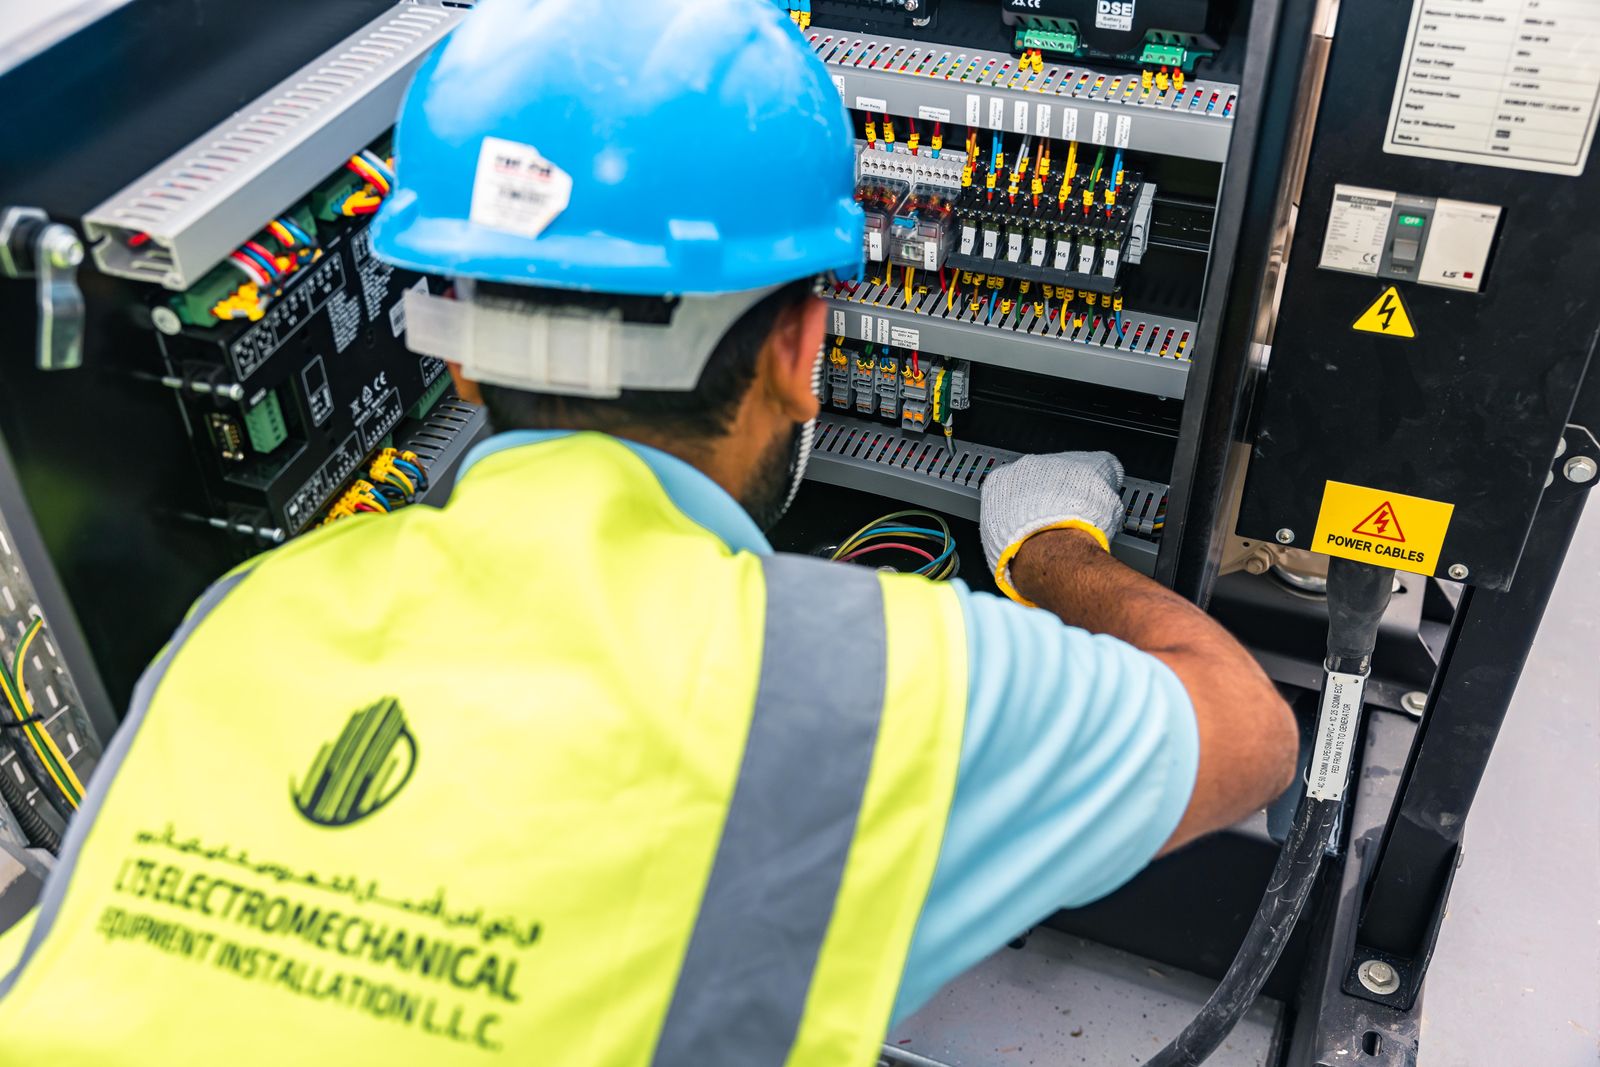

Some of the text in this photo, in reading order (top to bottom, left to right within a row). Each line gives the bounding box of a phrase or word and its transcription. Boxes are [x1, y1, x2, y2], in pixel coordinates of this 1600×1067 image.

[1100, 0, 1132, 16] DSE
[1404, 216, 1420, 225] OFF
[1326, 534, 1424, 562] POWER CABLES
[1339, 703, 1351, 732] GENERATOR
[1336, 740, 1344, 751] ATS
[1333, 751, 1342, 765] FROM
[1332, 764, 1340, 774] FED
[154, 865, 522, 1003] ELECTROMECHANICAL
[98, 905, 217, 959] EQUIPMENT
[216, 938, 420, 1027] INSTALLATION
